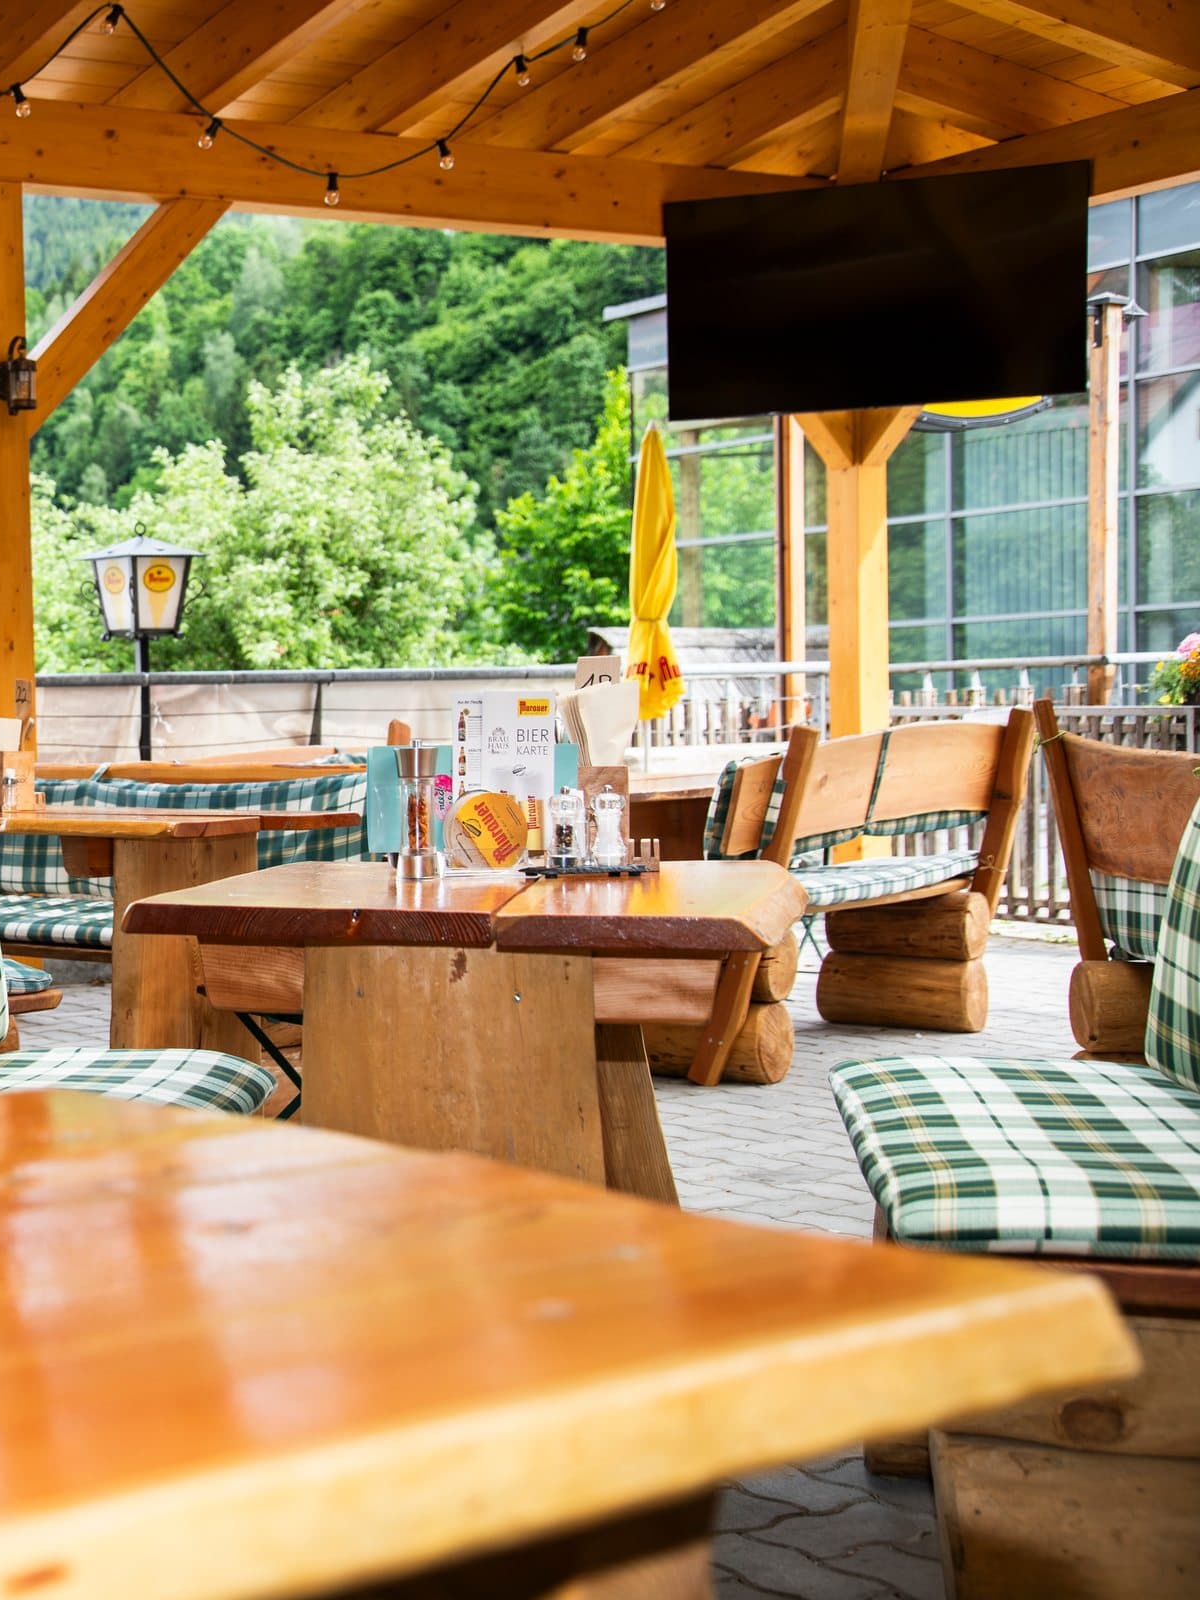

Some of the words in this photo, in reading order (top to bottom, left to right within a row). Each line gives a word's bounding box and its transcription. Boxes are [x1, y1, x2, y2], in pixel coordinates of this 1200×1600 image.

[519, 701, 549, 716] Murauer
[516, 728, 550, 743] BIER
[516, 745, 550, 756] KARTE
[527, 795, 544, 830] Murauer
[474, 802, 520, 864] Murauer
